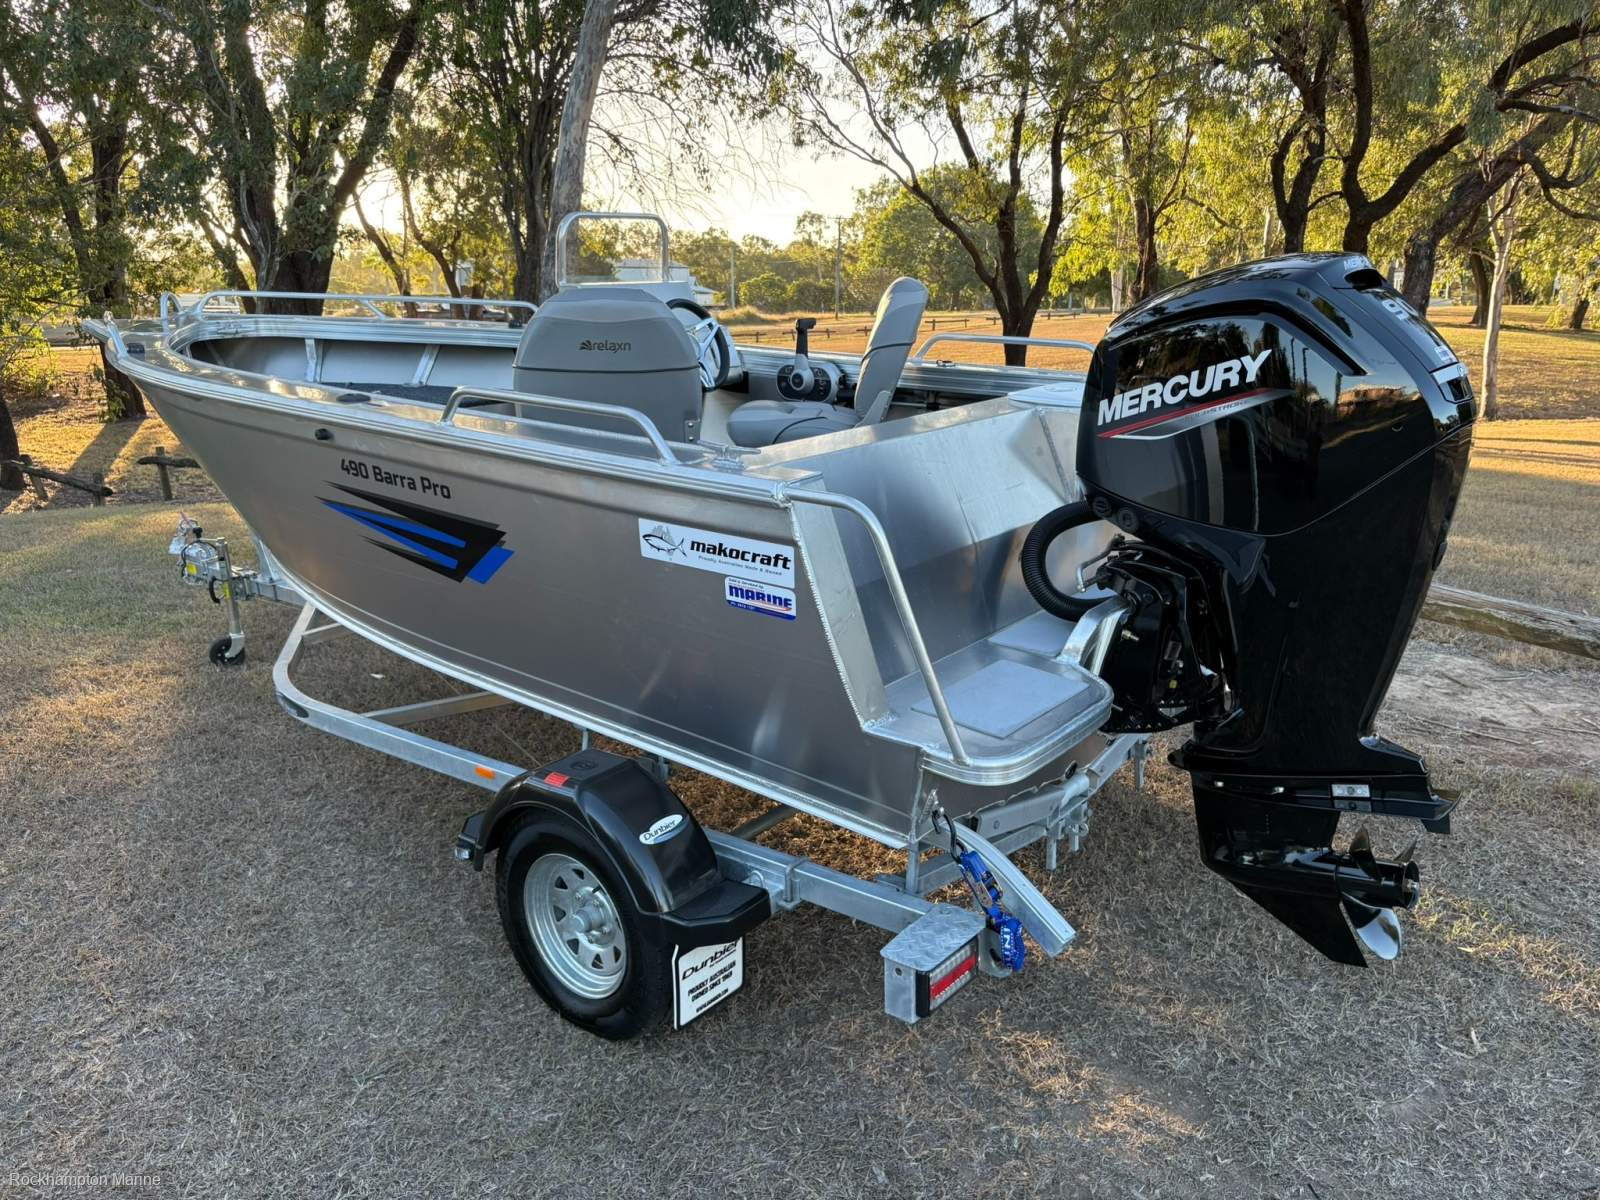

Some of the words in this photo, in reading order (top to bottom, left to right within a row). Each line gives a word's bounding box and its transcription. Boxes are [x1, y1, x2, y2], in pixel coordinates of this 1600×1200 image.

[1097, 349, 1273, 426] MERCURY
[341, 458, 369, 479] 490
[371, 465, 417, 491] Barra
[420, 475, 451, 499] Pro
[690, 540, 792, 570] makocraft
[728, 585, 793, 608] MARINE
[643, 819, 677, 841] Dunbier
[681, 940, 737, 981] Dunbier
